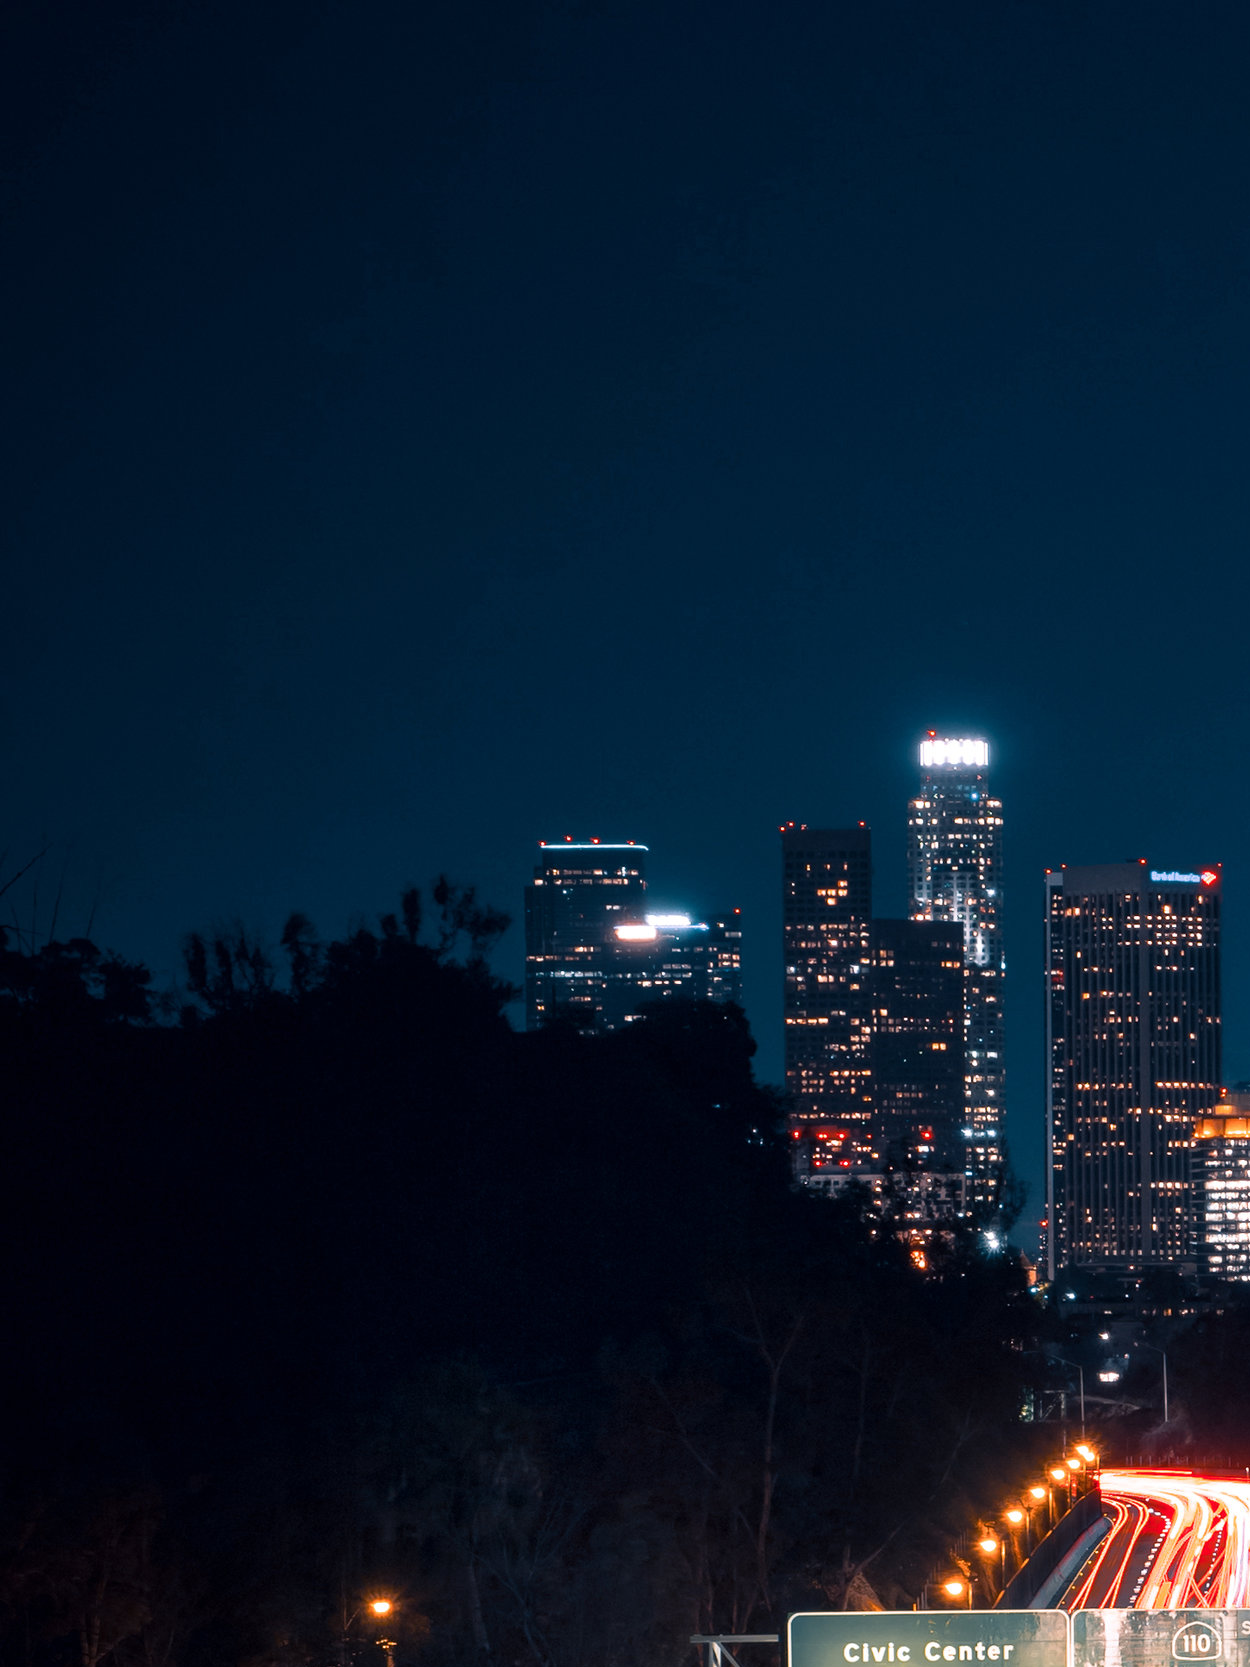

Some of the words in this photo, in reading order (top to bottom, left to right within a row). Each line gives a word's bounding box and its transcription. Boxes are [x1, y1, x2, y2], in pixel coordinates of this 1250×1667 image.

[843, 1642, 911, 1663] Civic
[924, 1641, 1014, 1661] Center
[1182, 1634, 1210, 1653] 110
